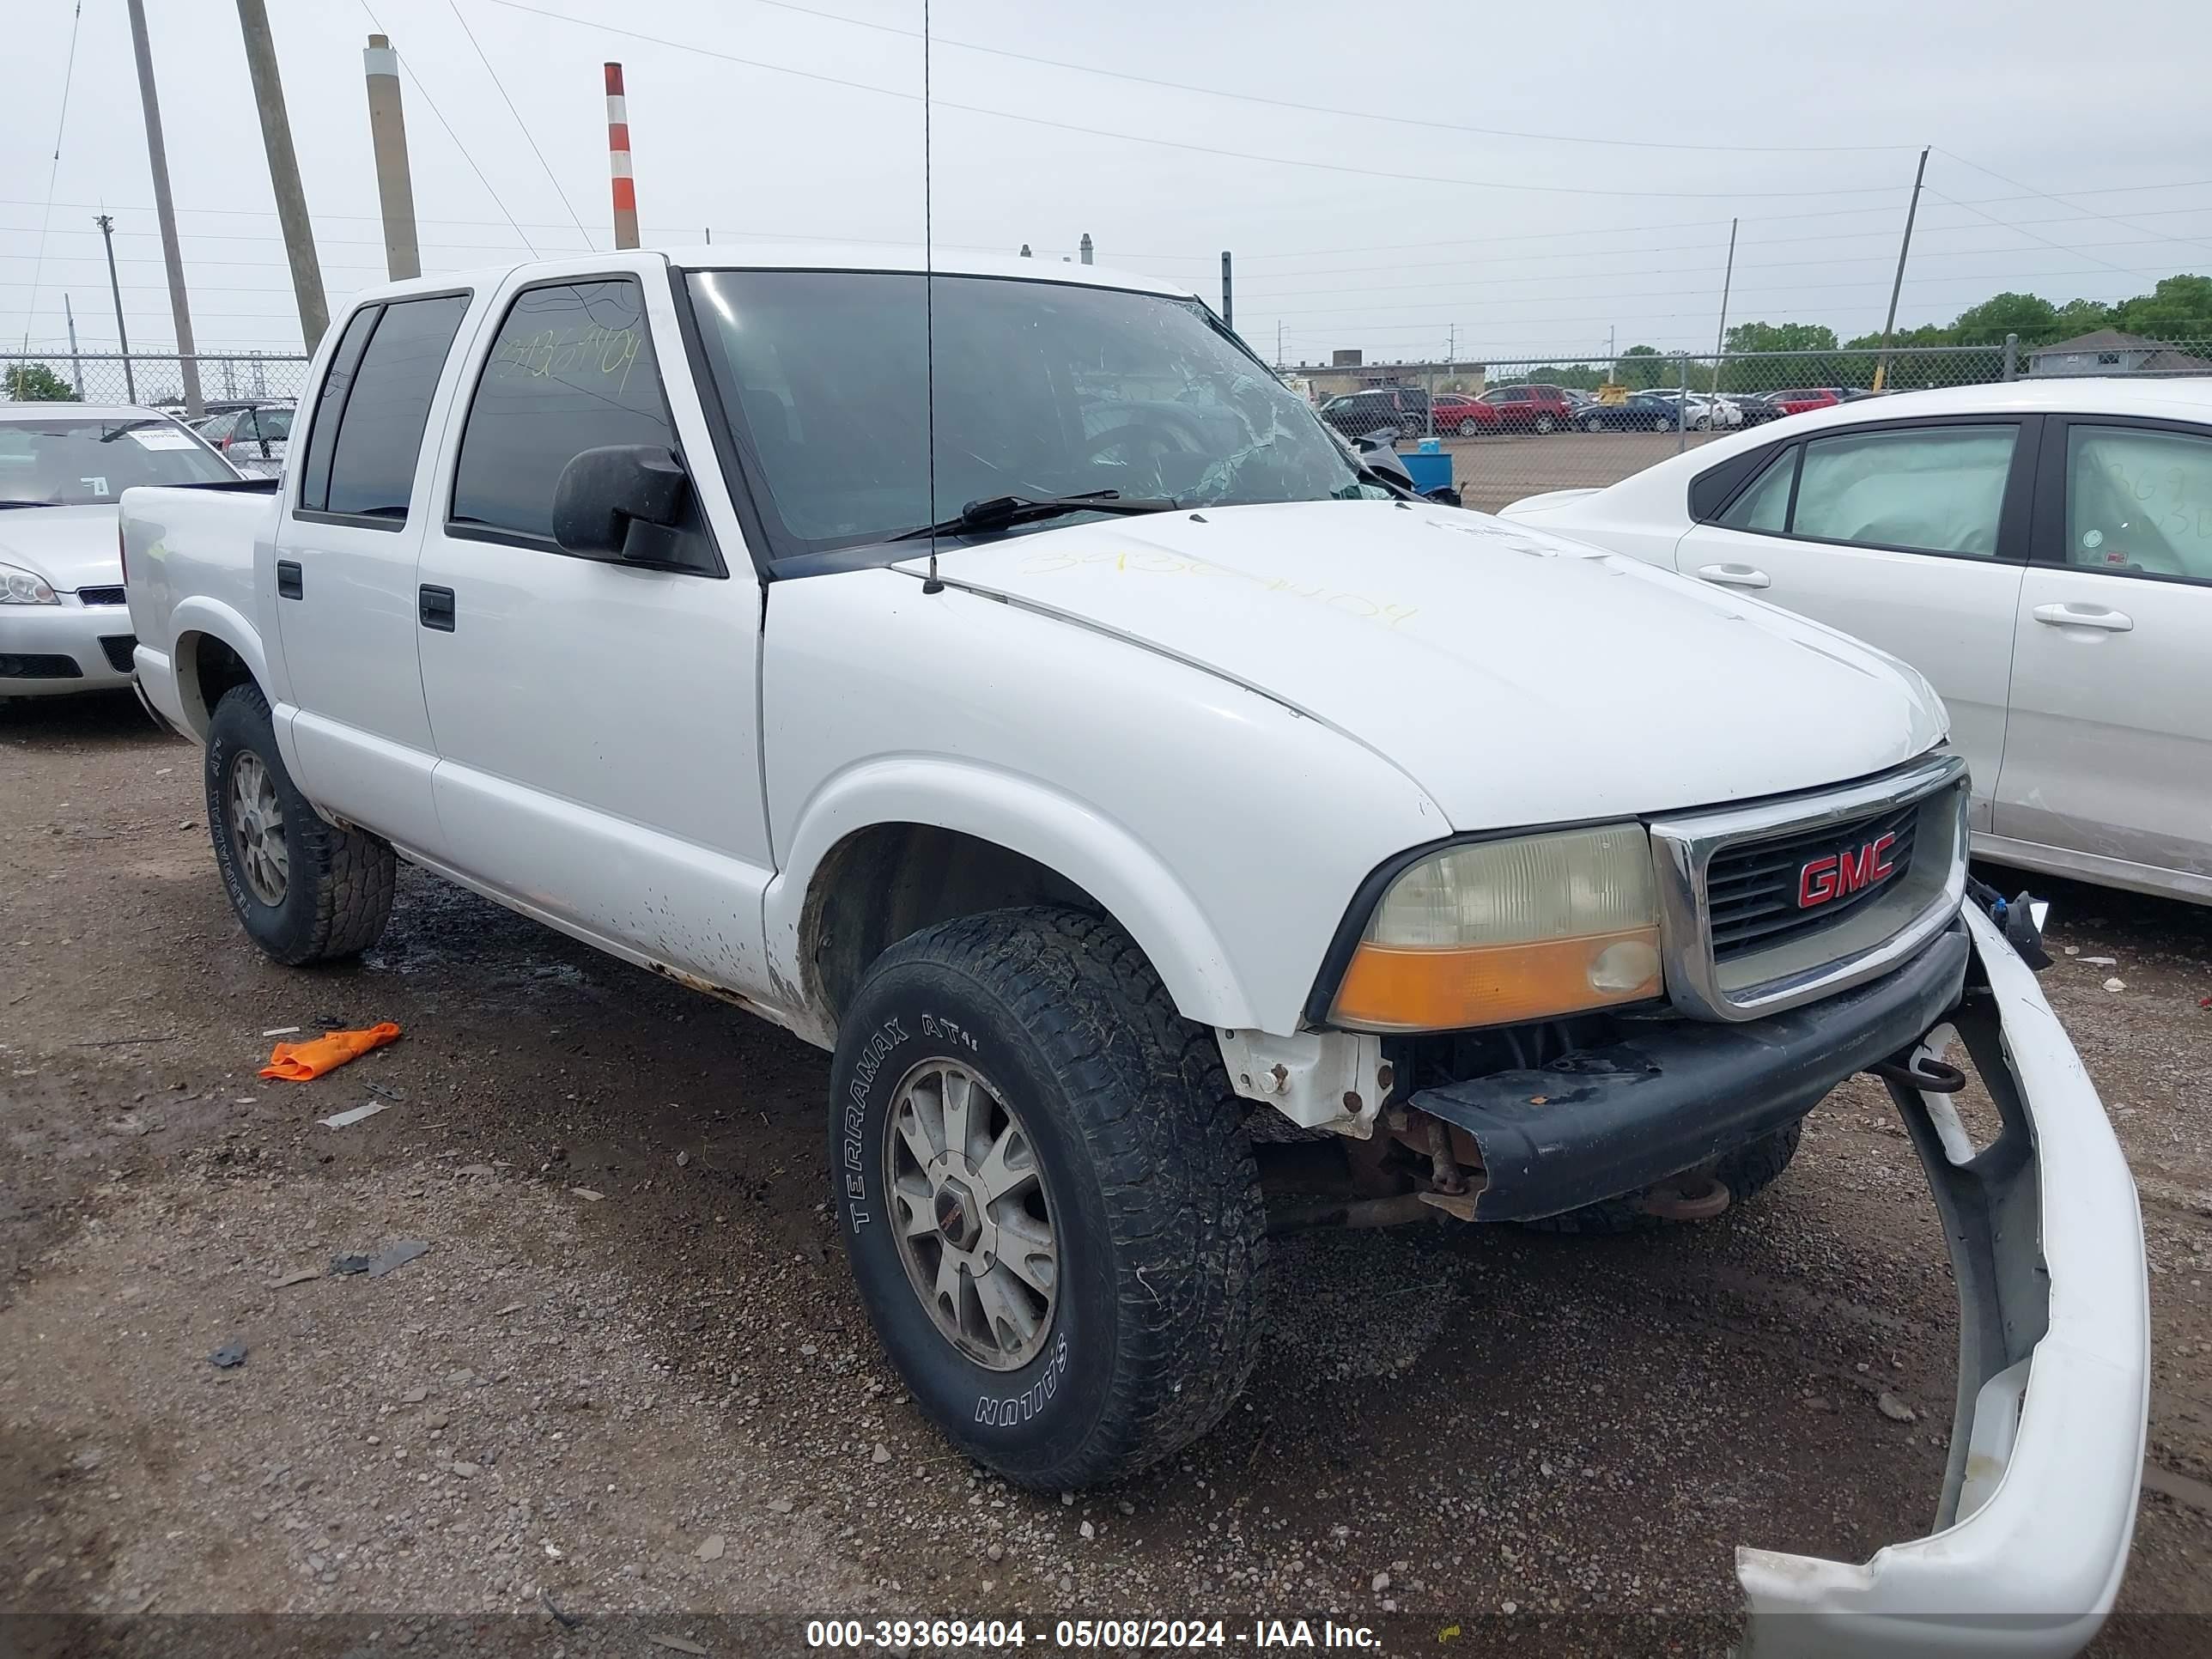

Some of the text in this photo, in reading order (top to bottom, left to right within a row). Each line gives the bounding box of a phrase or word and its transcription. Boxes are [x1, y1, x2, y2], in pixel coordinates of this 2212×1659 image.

[1798, 831, 1897, 909] GMC
[844, 1017, 910, 1234] TERRAMAX
[975, 1332, 1068, 1427] SAILUN
